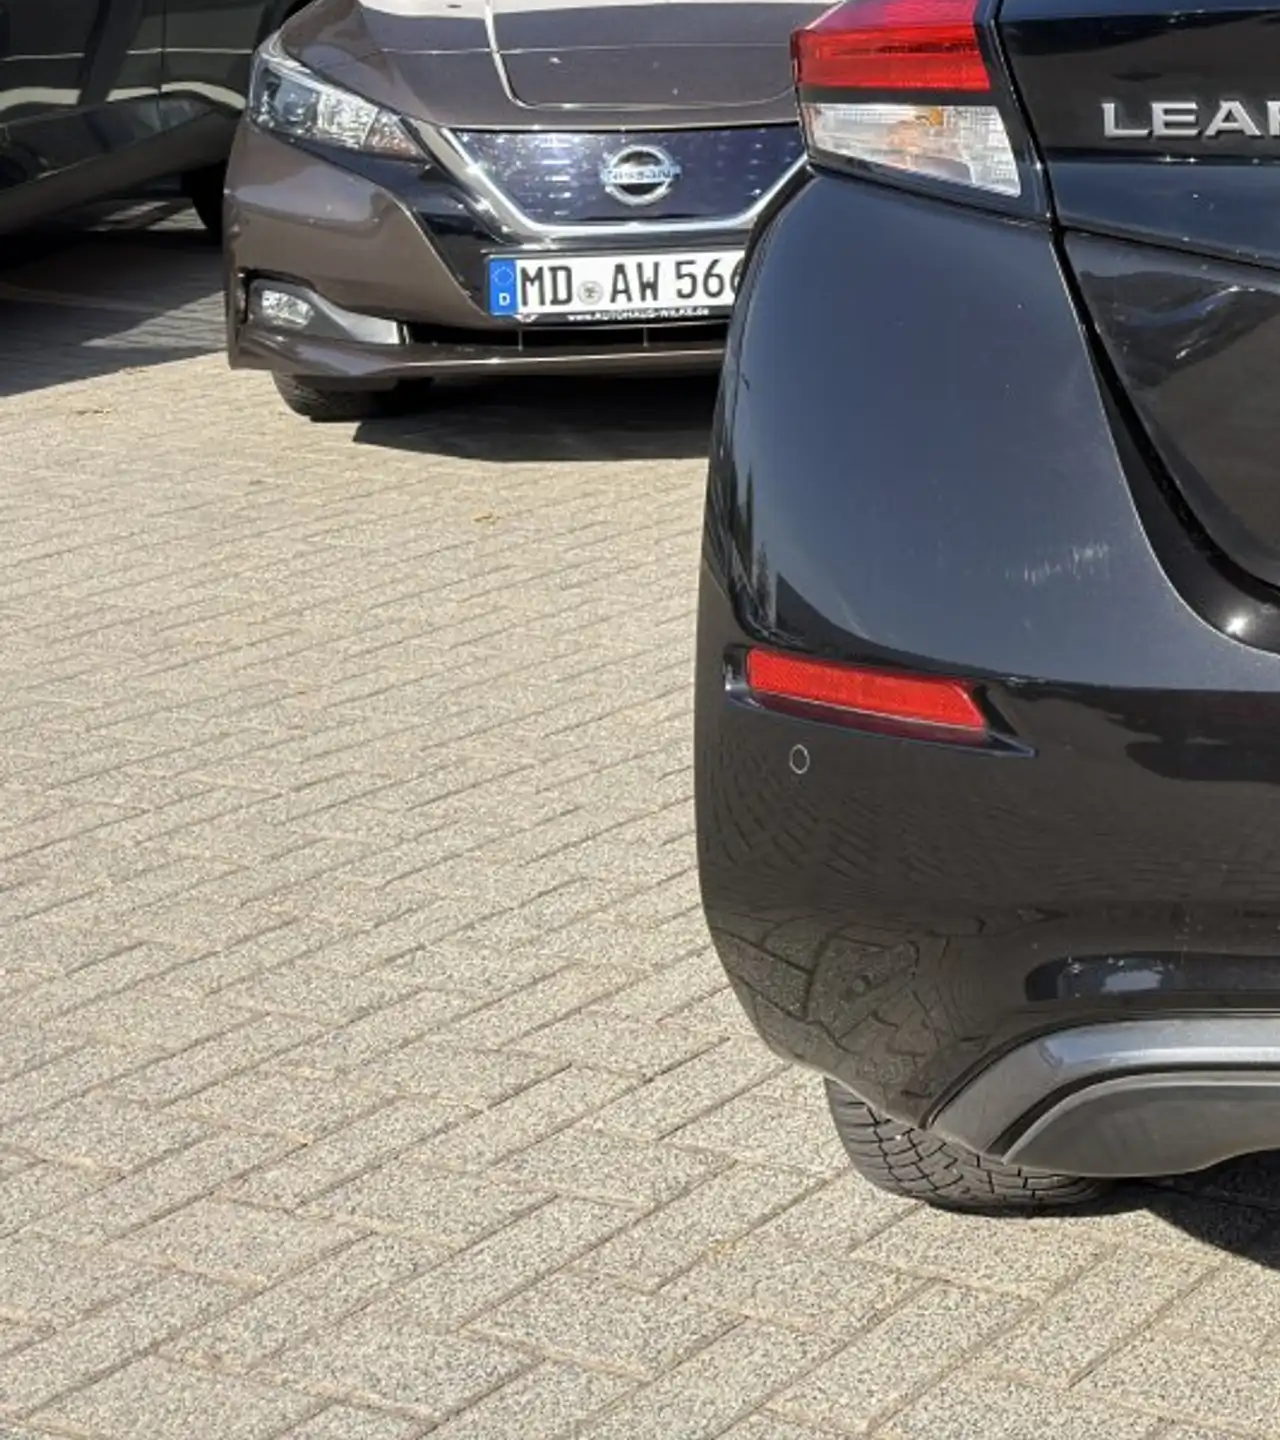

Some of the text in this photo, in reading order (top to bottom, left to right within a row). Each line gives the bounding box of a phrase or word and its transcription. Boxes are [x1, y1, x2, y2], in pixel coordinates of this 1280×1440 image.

[520, 266, 573, 307] MD
[610, 259, 660, 304] AW
[499, 293, 510, 306] D
